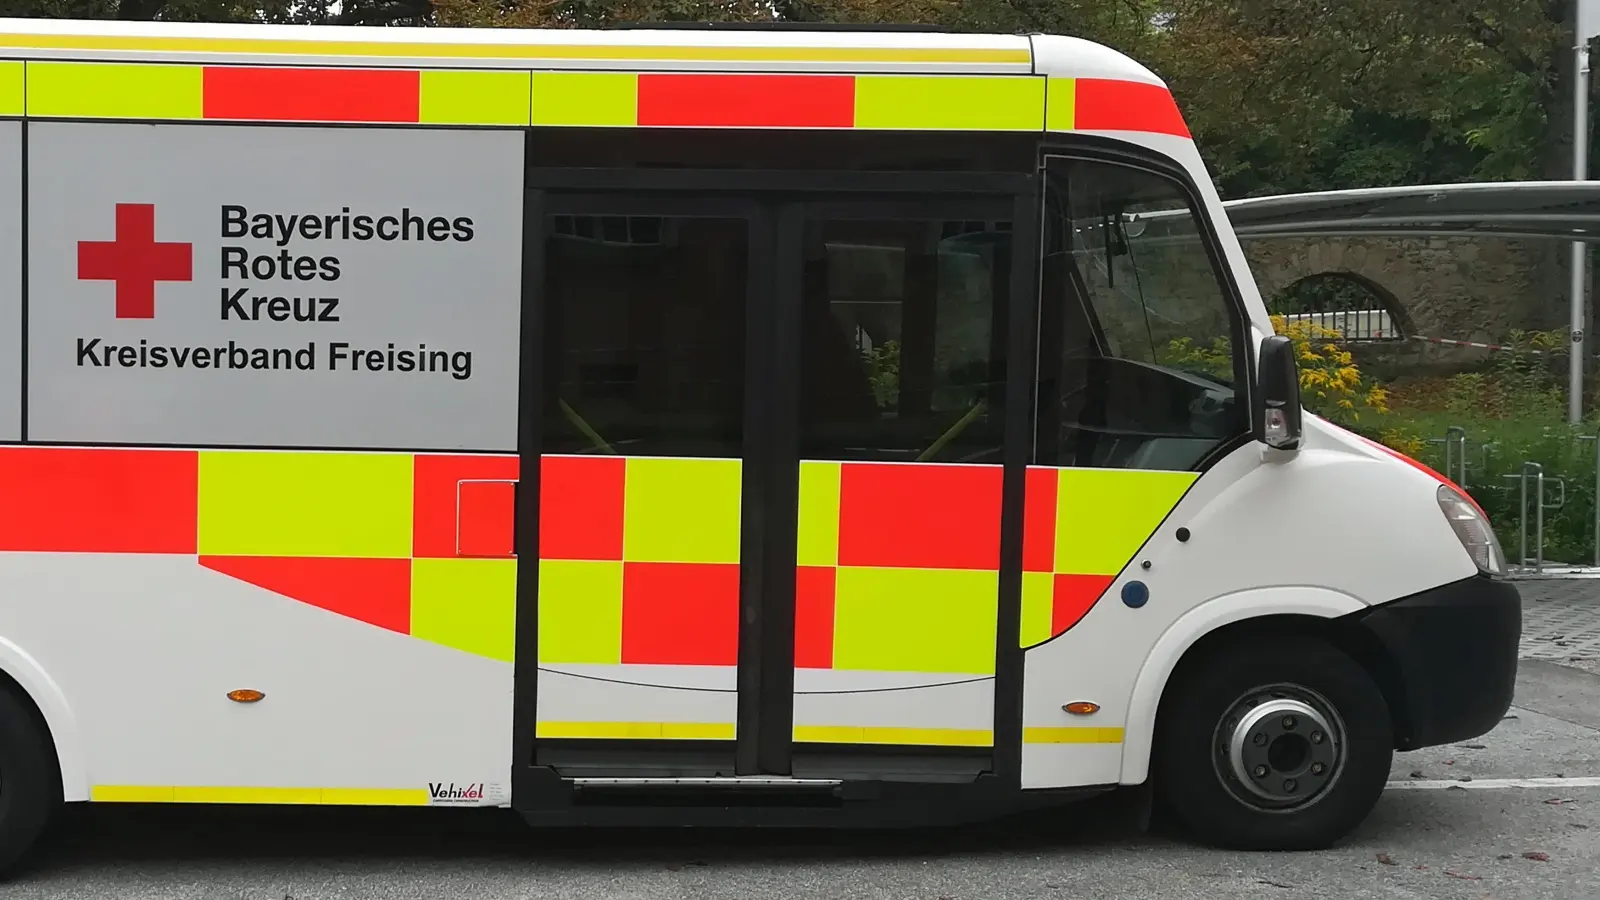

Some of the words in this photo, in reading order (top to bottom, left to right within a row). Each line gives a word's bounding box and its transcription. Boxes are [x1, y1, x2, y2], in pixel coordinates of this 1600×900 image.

[221, 204, 474, 247] Bayerisches
[220, 247, 341, 282] Rotes
[220, 287, 340, 322] Kreuz
[76, 337, 315, 370] Kreisverband
[329, 342, 472, 381] Freising
[428, 782, 484, 799] Vehixel
